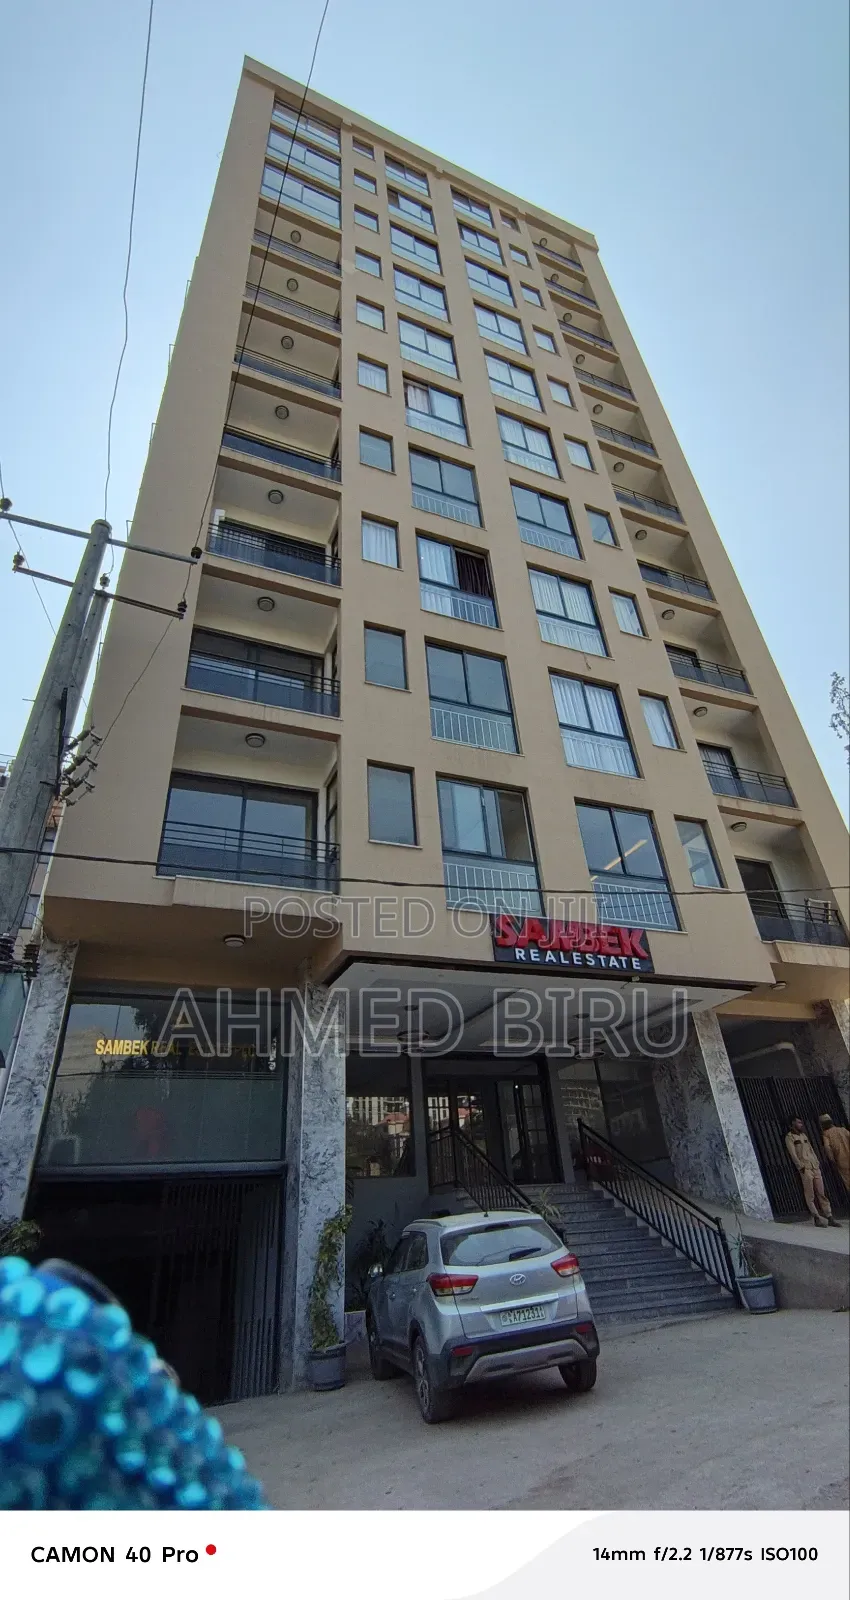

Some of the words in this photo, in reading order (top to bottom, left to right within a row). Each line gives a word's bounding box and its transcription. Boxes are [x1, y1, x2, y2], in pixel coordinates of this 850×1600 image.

[496, 913, 649, 960] SAMBEK
[514, 947, 642, 970] REALESTATE
[95, 1039, 149, 1056] SAMBEK
